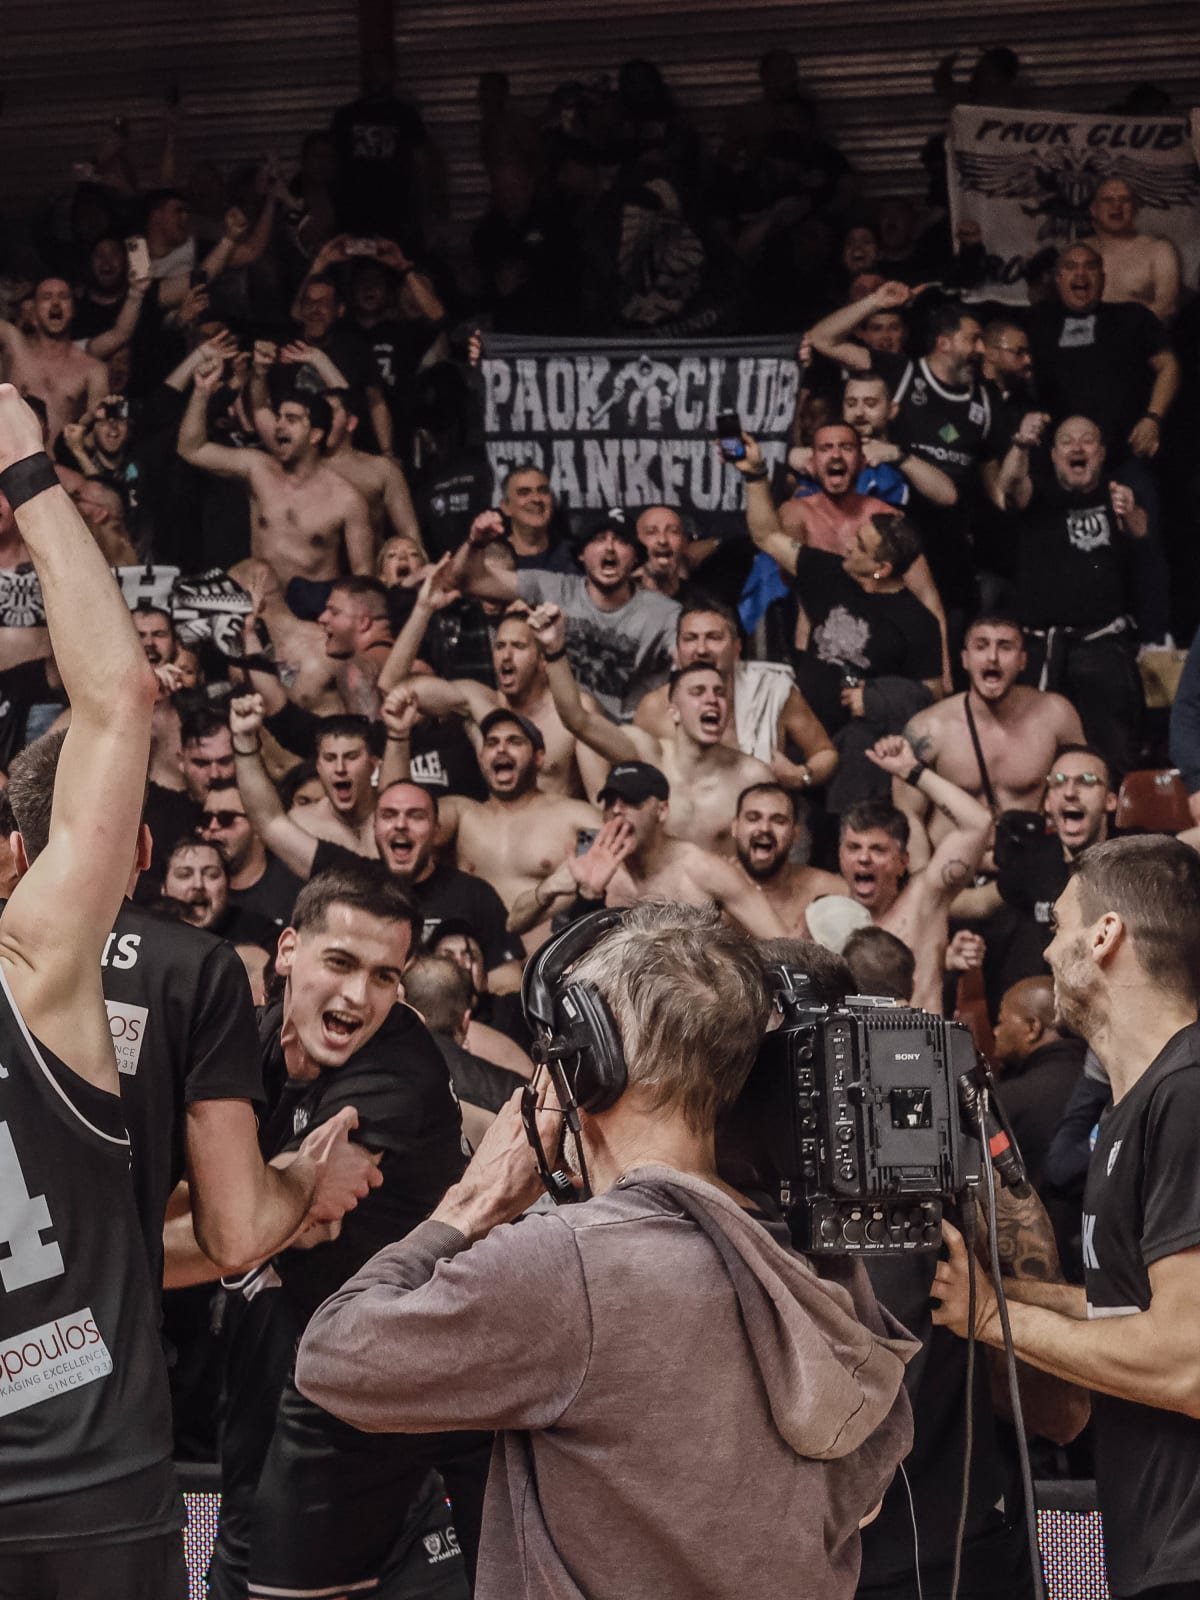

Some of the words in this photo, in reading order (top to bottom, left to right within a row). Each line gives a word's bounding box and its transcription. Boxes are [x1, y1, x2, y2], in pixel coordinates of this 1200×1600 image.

[1087, 123, 1186, 151] CLUB
[481, 356, 611, 432] PAOK
[674, 357, 800, 433] CLUB
[895, 1053, 921, 1061] SONY
[43, 1348, 108, 1380] EXCELLENCE
[48, 1372, 85, 1394] SINCE
